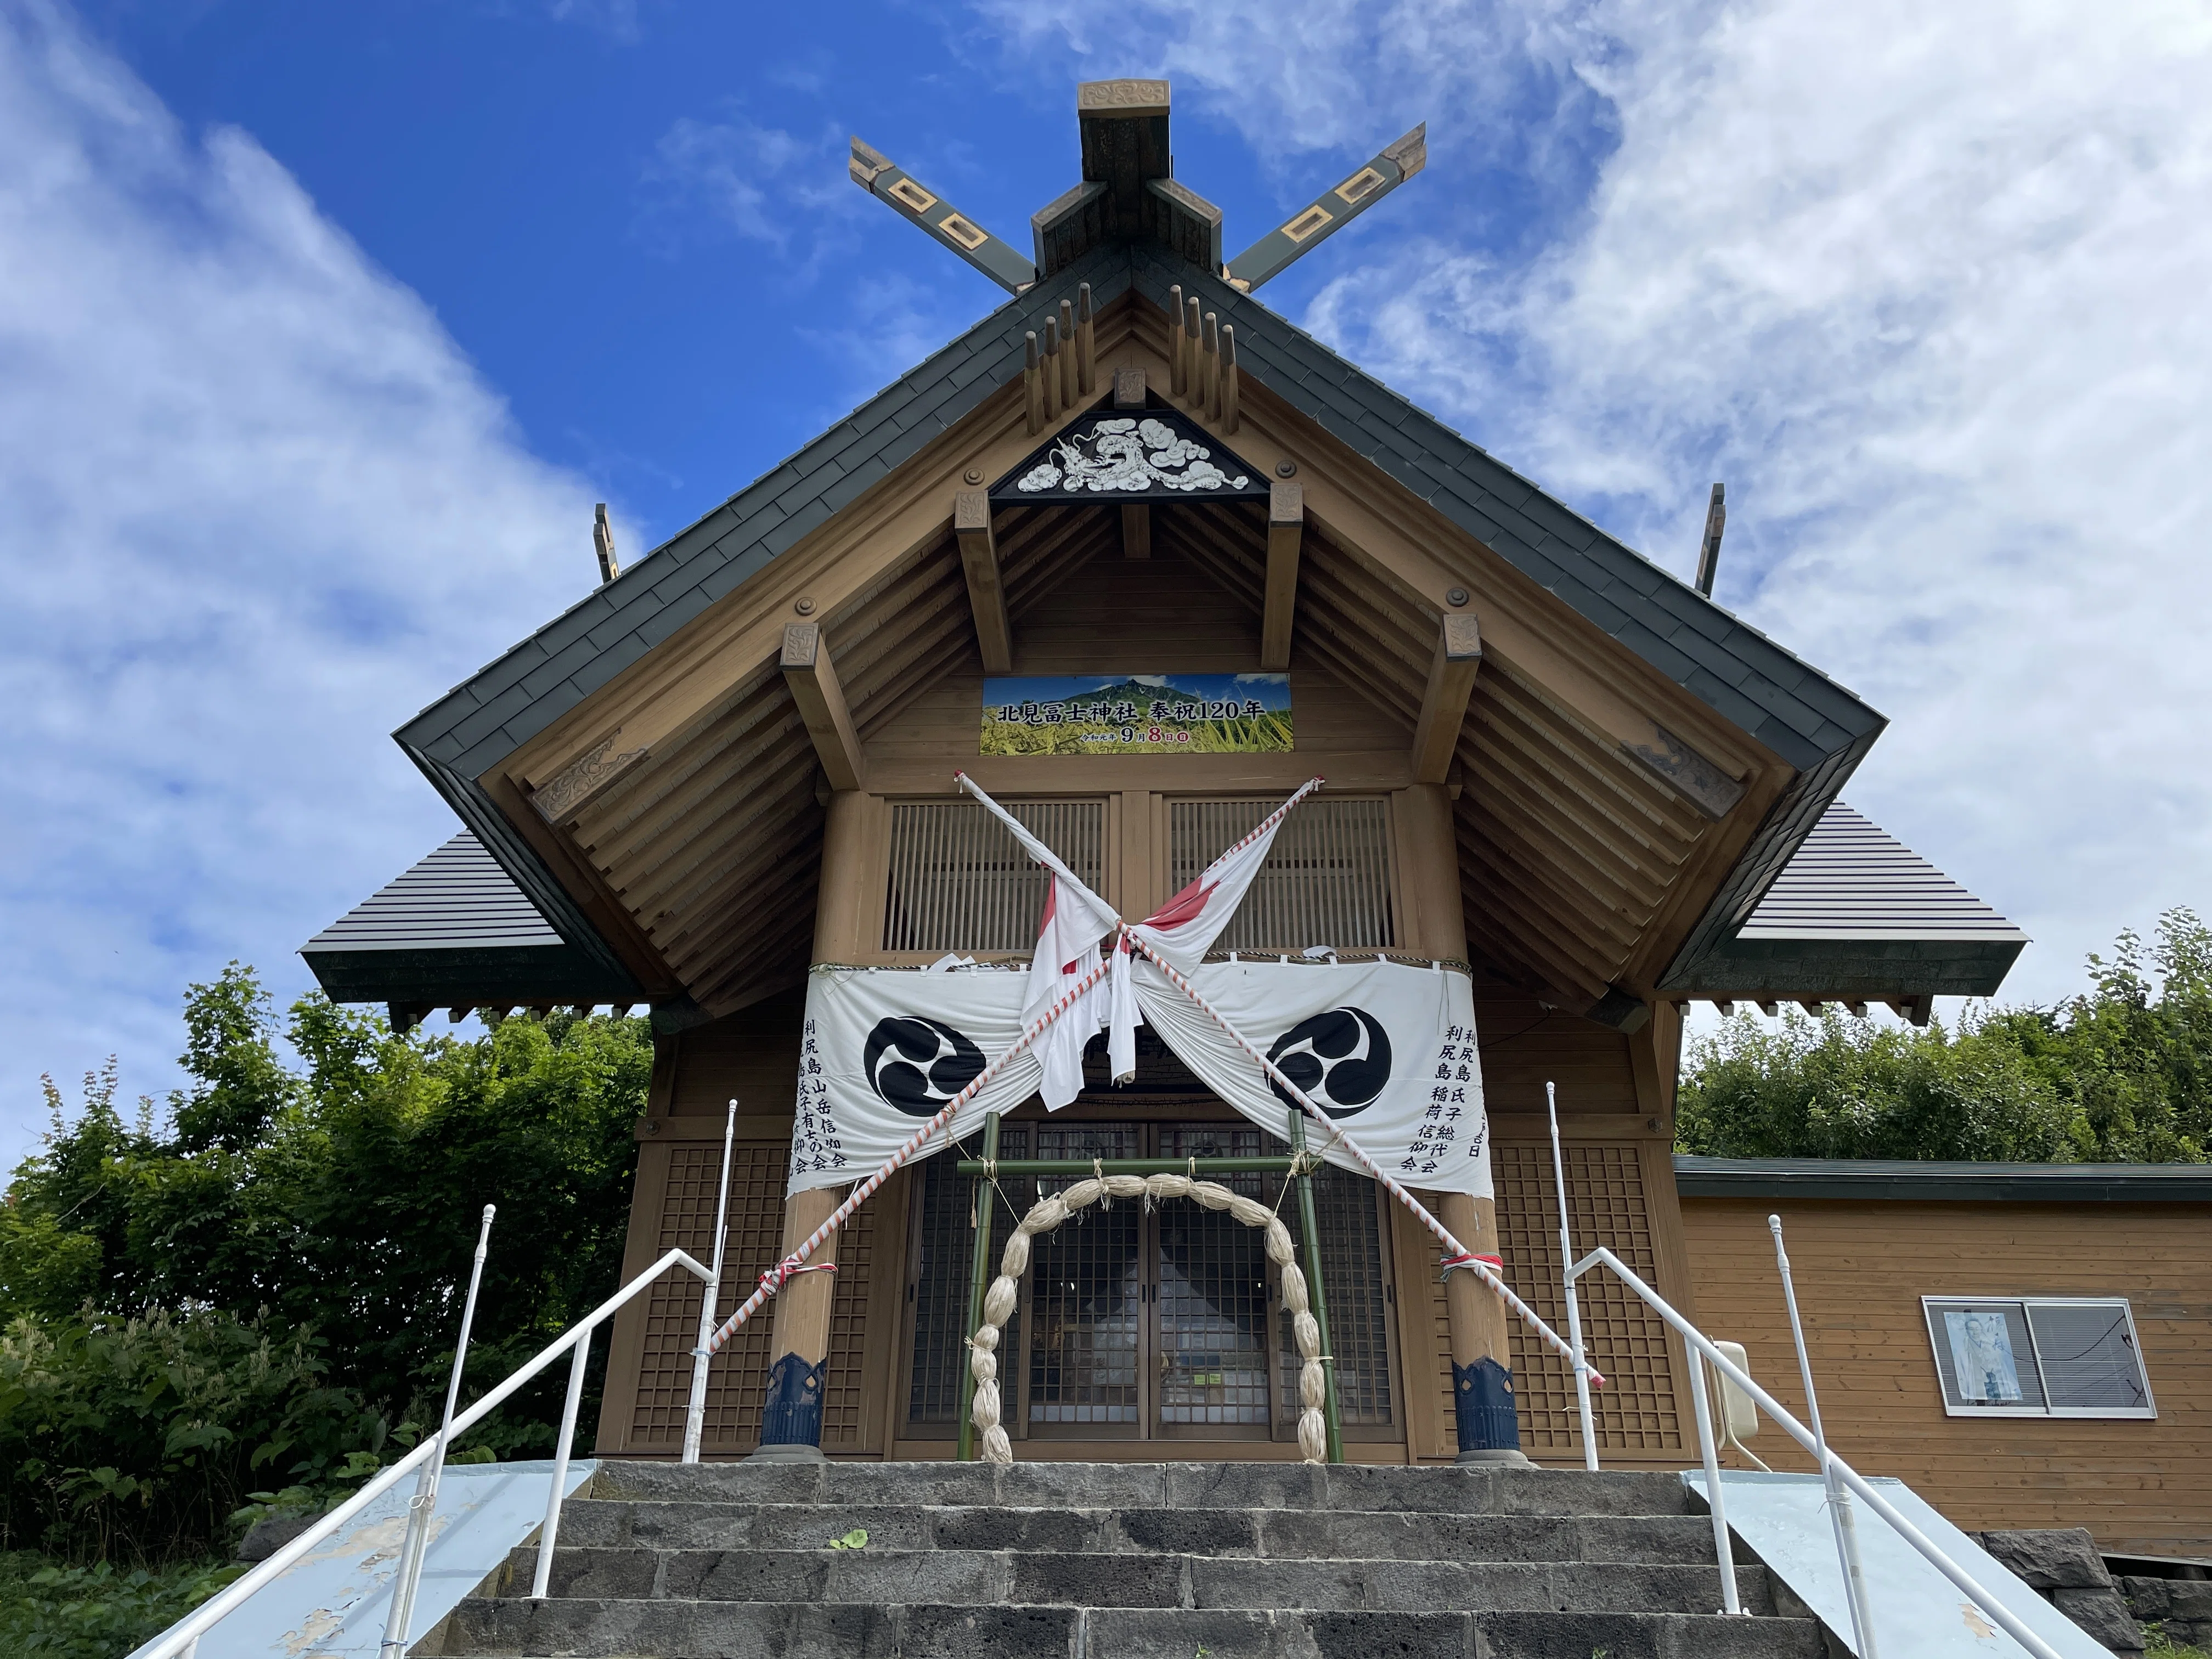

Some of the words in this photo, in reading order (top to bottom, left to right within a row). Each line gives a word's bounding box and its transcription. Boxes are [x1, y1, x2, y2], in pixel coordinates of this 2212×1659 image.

[997, 702, 1138, 723] 北見冨士神社
[1149, 700, 1266, 721] 奉祝120年
[804, 1019, 848, 1167] 利尻島山岳信仰会
[1400, 1025, 1463, 1171] 利尻島稲荷信仰会
[1421, 1029, 1476, 1173] 利尻島氏子総代会
